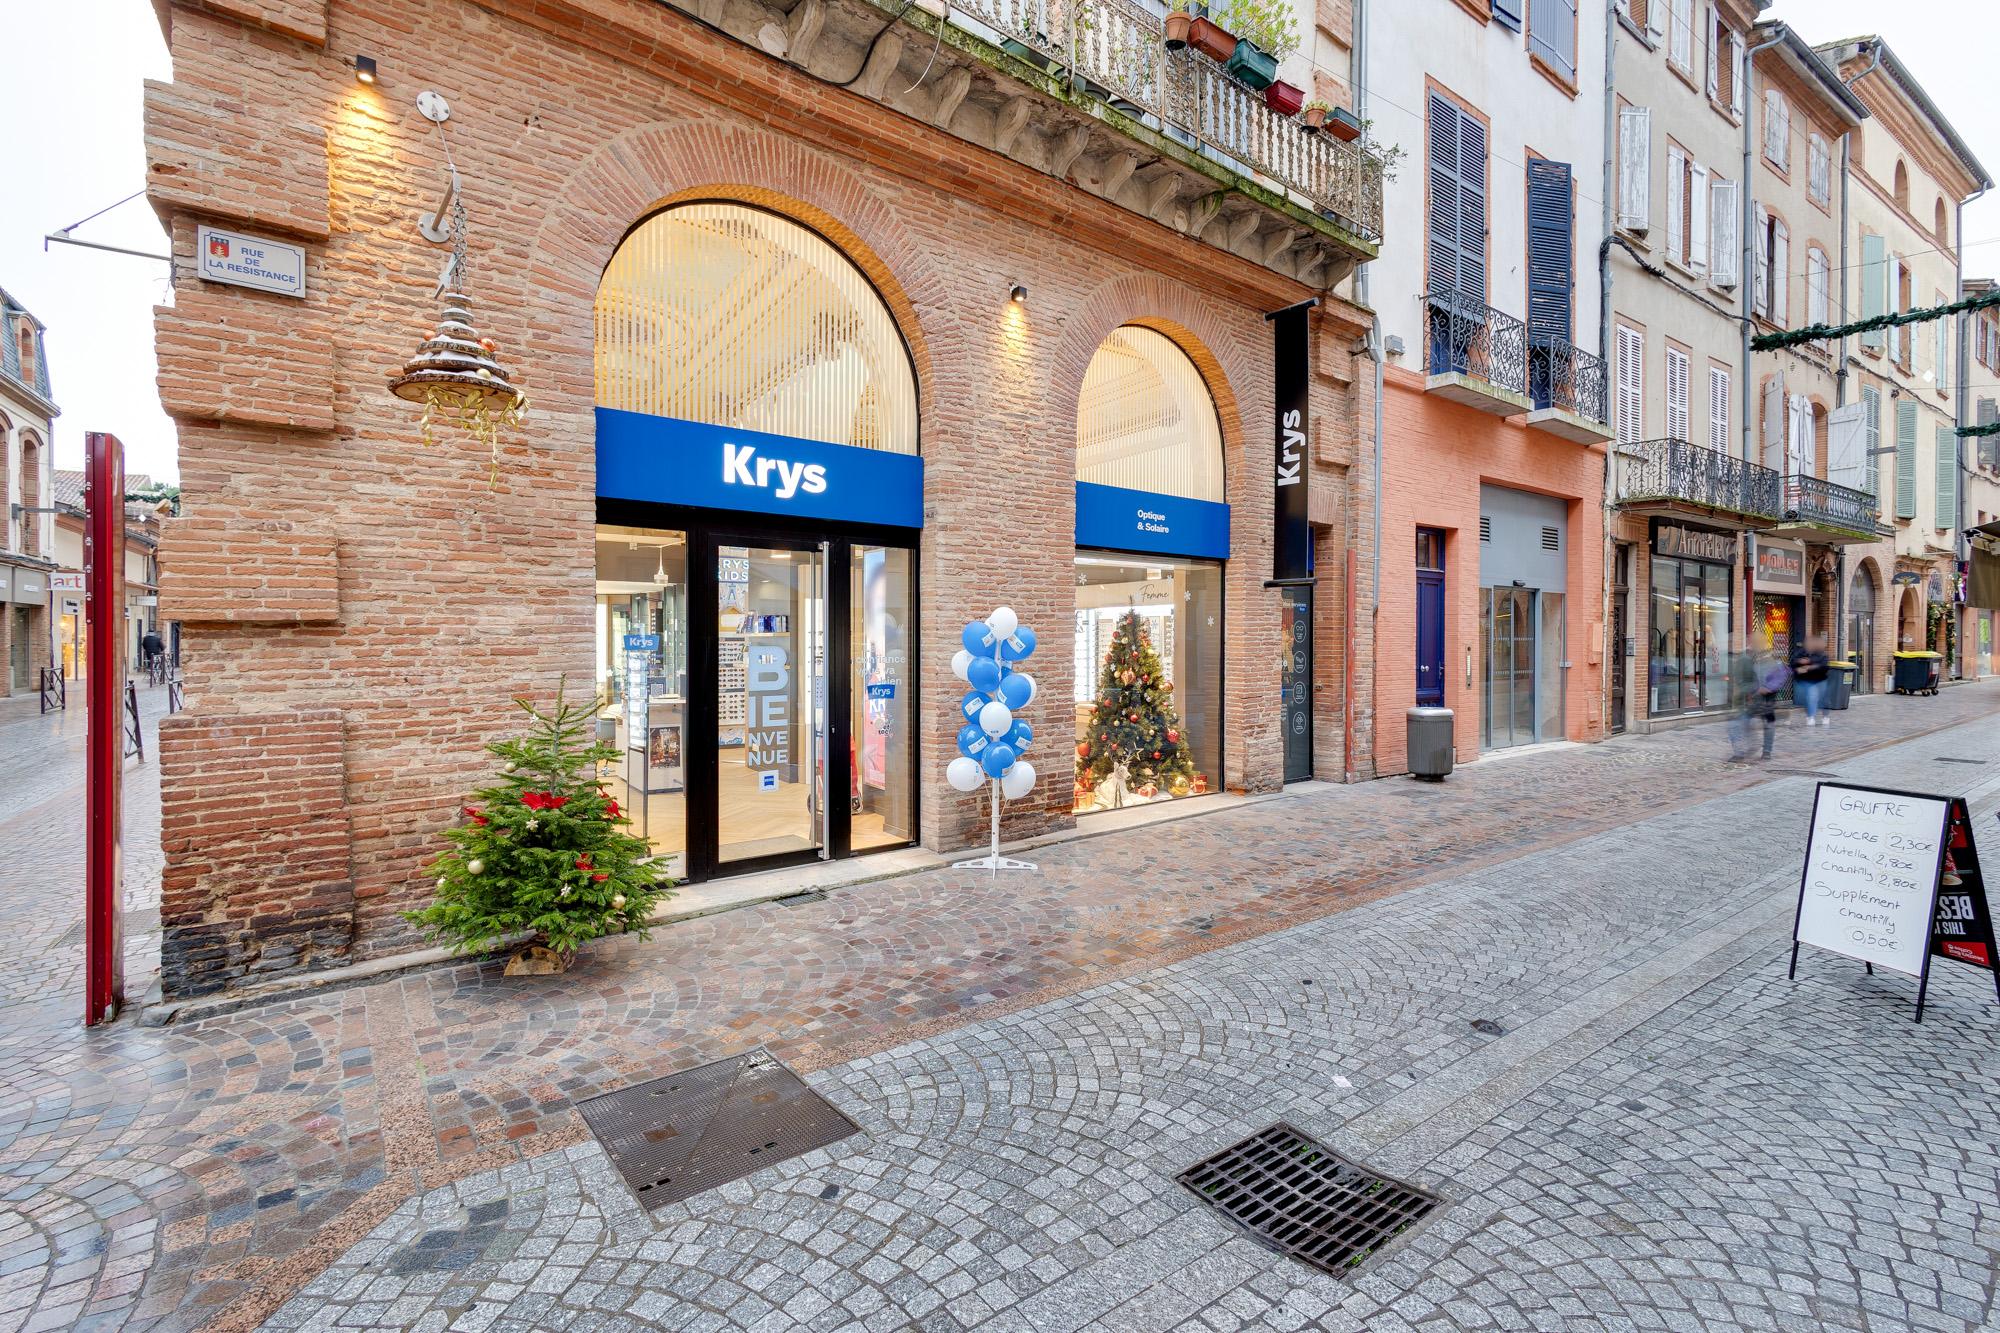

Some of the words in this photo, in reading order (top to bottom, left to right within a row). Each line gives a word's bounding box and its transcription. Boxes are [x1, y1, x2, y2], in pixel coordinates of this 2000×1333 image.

[241, 247, 264, 258] RUE
[245, 257, 260, 266] DE
[209, 259, 224, 269] LA
[227, 263, 296, 283] RESISTANCE
[1278, 409, 1306, 486] Krys
[723, 443, 827, 499] Krys
[1137, 509, 1166, 522] Optique
[1137, 521, 1145, 531] &
[1145, 522, 1170, 534] Solaire
[53, 575, 83, 589] art
[1137, 583, 1169, 602] Femme
[629, 637, 654, 648] Krys
[871, 687, 891, 697] Krys
[748, 730, 789, 747] NVE
[748, 749, 789, 767] NUE
[1839, 795, 1910, 818] GAUFRE
[1889, 835, 1936, 852] 2,30€
[1825, 844, 1871, 862] Nutella
[1875, 854, 1914, 870] 2,80€
[1878, 874, 1918, 890] 2,80€
[1814, 881, 1901, 910] Supplément
[1936, 895, 1975, 920] BES
[1942, 921, 1967, 935] THIS
[1851, 930, 1899, 950] 0,50€
